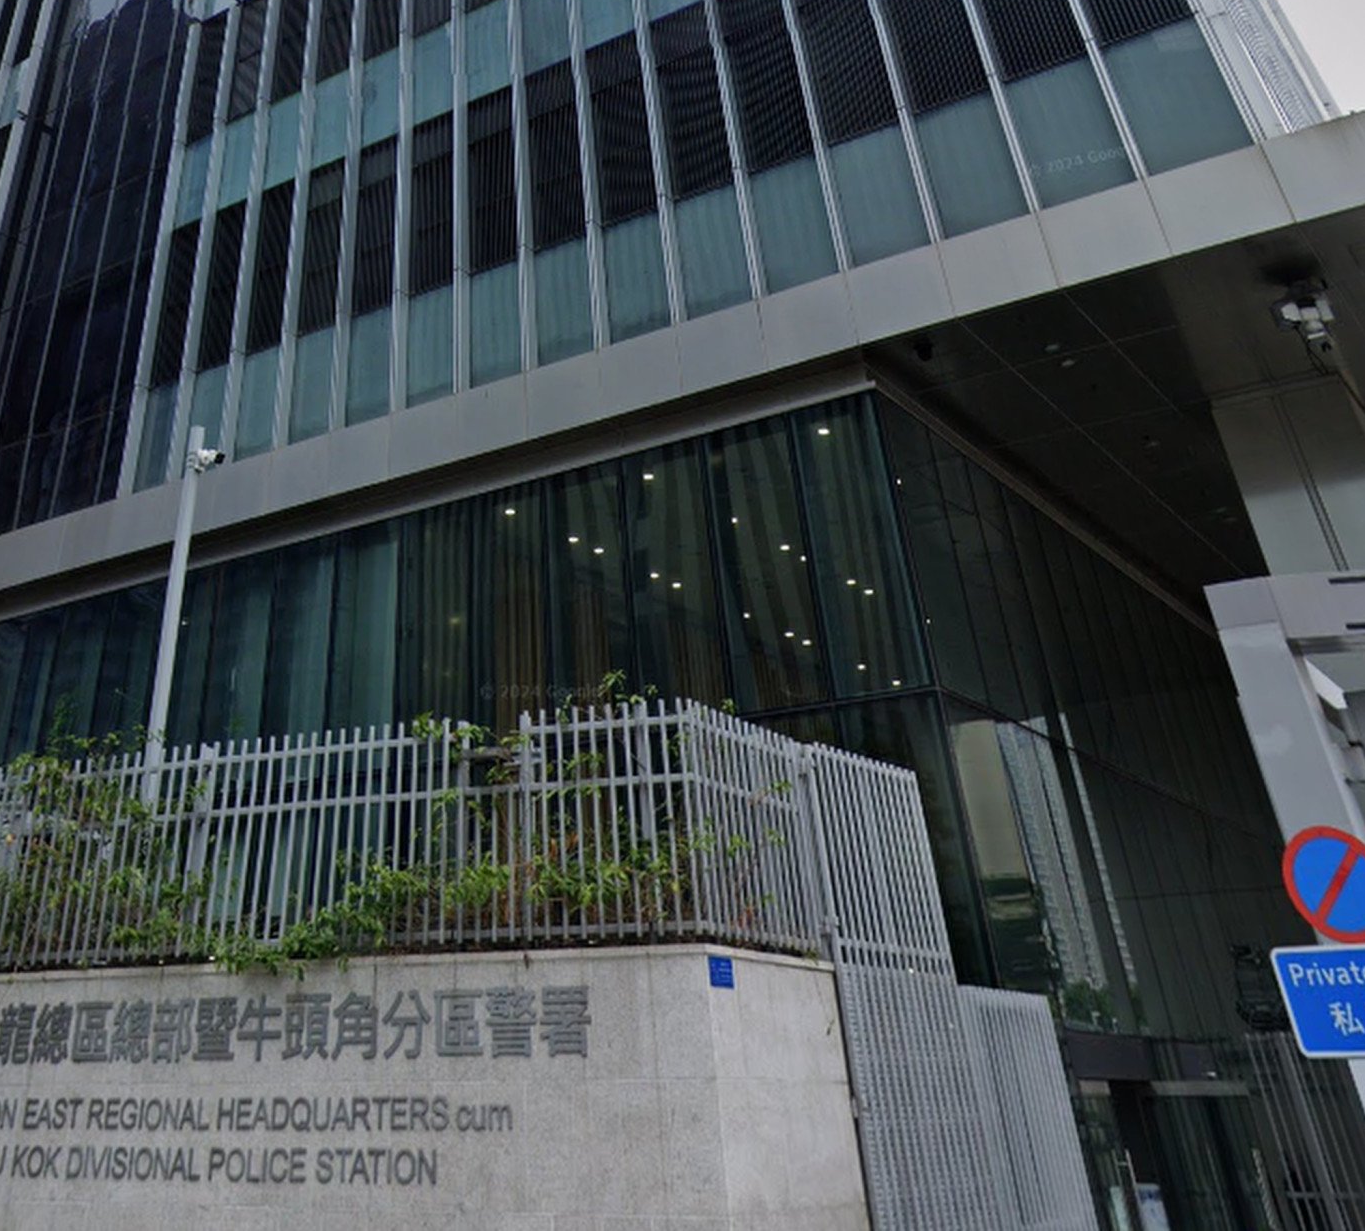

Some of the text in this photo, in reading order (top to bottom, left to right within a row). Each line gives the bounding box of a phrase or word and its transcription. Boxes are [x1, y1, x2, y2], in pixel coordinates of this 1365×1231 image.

[22, 1098, 84, 1131] EAST
[86, 1098, 211, 1131] REGIONAL
[217, 1096, 449, 1133] HEADQUARTERS
[456, 1101, 514, 1132] cum
[10, 1145, 63, 1179] KOK
[65, 1146, 201, 1182] DIVISIONAL
[207, 1147, 308, 1183] POLICE
[315, 1148, 438, 1187] STATION
